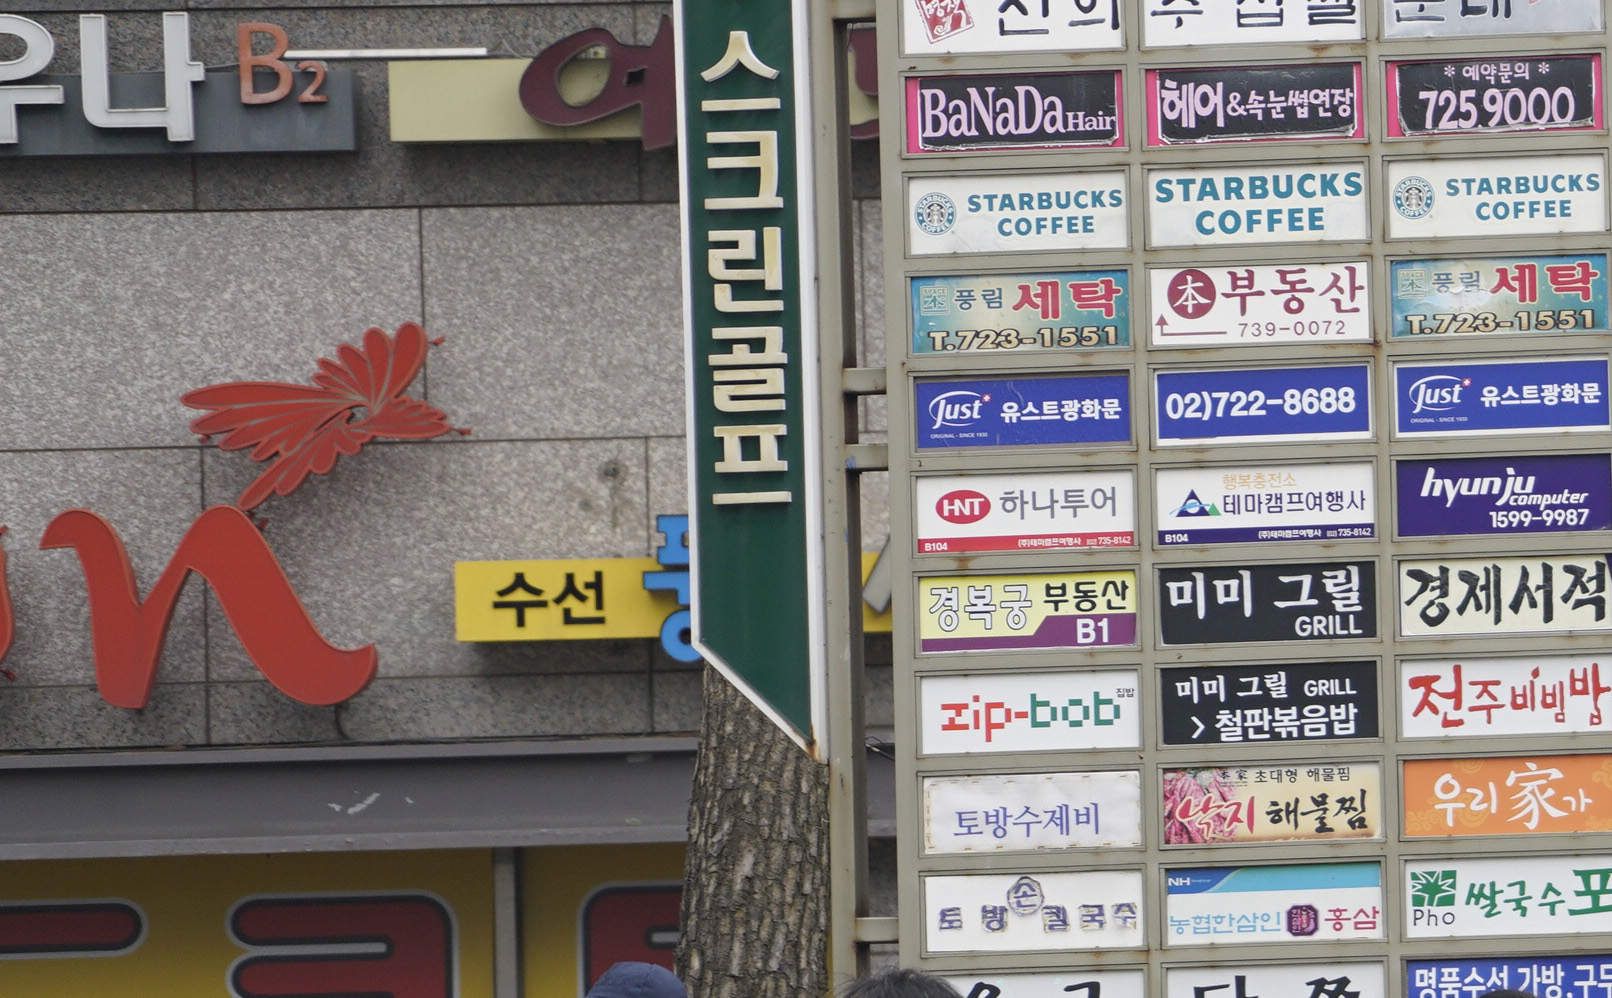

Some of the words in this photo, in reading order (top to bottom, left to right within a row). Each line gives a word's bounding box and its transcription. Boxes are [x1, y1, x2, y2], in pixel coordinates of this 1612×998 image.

[1462, 62, 1530, 84] 예약문의
[921, 85, 1066, 138] BaNaDa
[1066, 110, 1116, 132] Hair
[1155, 172, 1363, 204] STARBUCKS
[1446, 172, 1600, 197] STARBUCKS
[967, 189, 1123, 213] STARBUCKS
[1475, 200, 1572, 221] COFFEE
[997, 215, 1095, 237] COFFEE
[1195, 207, 1325, 236] COFFEE
[700, 30, 793, 506] 스크린골프
[1221, 265, 1365, 317] 부동산
[1490, 261, 1600, 303] 세탁
[954, 287, 1003, 311] 풍림
[1011, 278, 1123, 320] 세탁
[1238, 319, 1346, 337] 739-0072
[1404, 309, 1596, 335] T.723-1551
[927, 326, 1119, 351] T.723-1551
[1166, 386, 1356, 421] 02)722-8688
[1412, 383, 1463, 414] Just
[1480, 382, 1602, 408] 유스트광화문
[932, 399, 983, 430] Just
[1000, 398, 1122, 424] 유스트광화문
[1222, 472, 1297, 490] 행복충전소
[943, 498, 985, 517] HNT
[999, 486, 1117, 520] 하나투어
[1222, 490, 1366, 516] 테마캠프여행사
[1509, 489, 1589, 510] computer
[1489, 508, 1590, 529] 1599-9987
[1097, 535, 1131, 545] 735-8142
[1164, 533, 1189, 543] B104
[1338, 527, 1372, 537] 735-8142
[924, 542, 948, 551] B104
[491, 571, 607, 628] 수선
[1166, 569, 1252, 620] 미미
[1275, 565, 1363, 612] 그릴
[1404, 561, 1607, 627] 경제서적
[929, 584, 1033, 633] 경복궁
[1043, 579, 1129, 612] 부동산
[1076, 618, 1109, 644] B1
[1295, 615, 1363, 637] GRILL
[1175, 675, 1226, 703] 미미
[1236, 671, 1287, 698] 그릴
[1304, 678, 1357, 696] GRILL
[1215, 703, 1359, 743] 철판볶음밥
[1254, 768, 1298, 783] 초대형
[1306, 767, 1351, 782] 해물찜
[953, 802, 1101, 838] 토방수제비
[1265, 788, 1369, 833] 해물찜
[1168, 877, 1191, 887] NH
[1169, 911, 1281, 936] 농협한삼인
[1324, 906, 1380, 932] 홍삼
[1413, 908, 1456, 927] Pho
